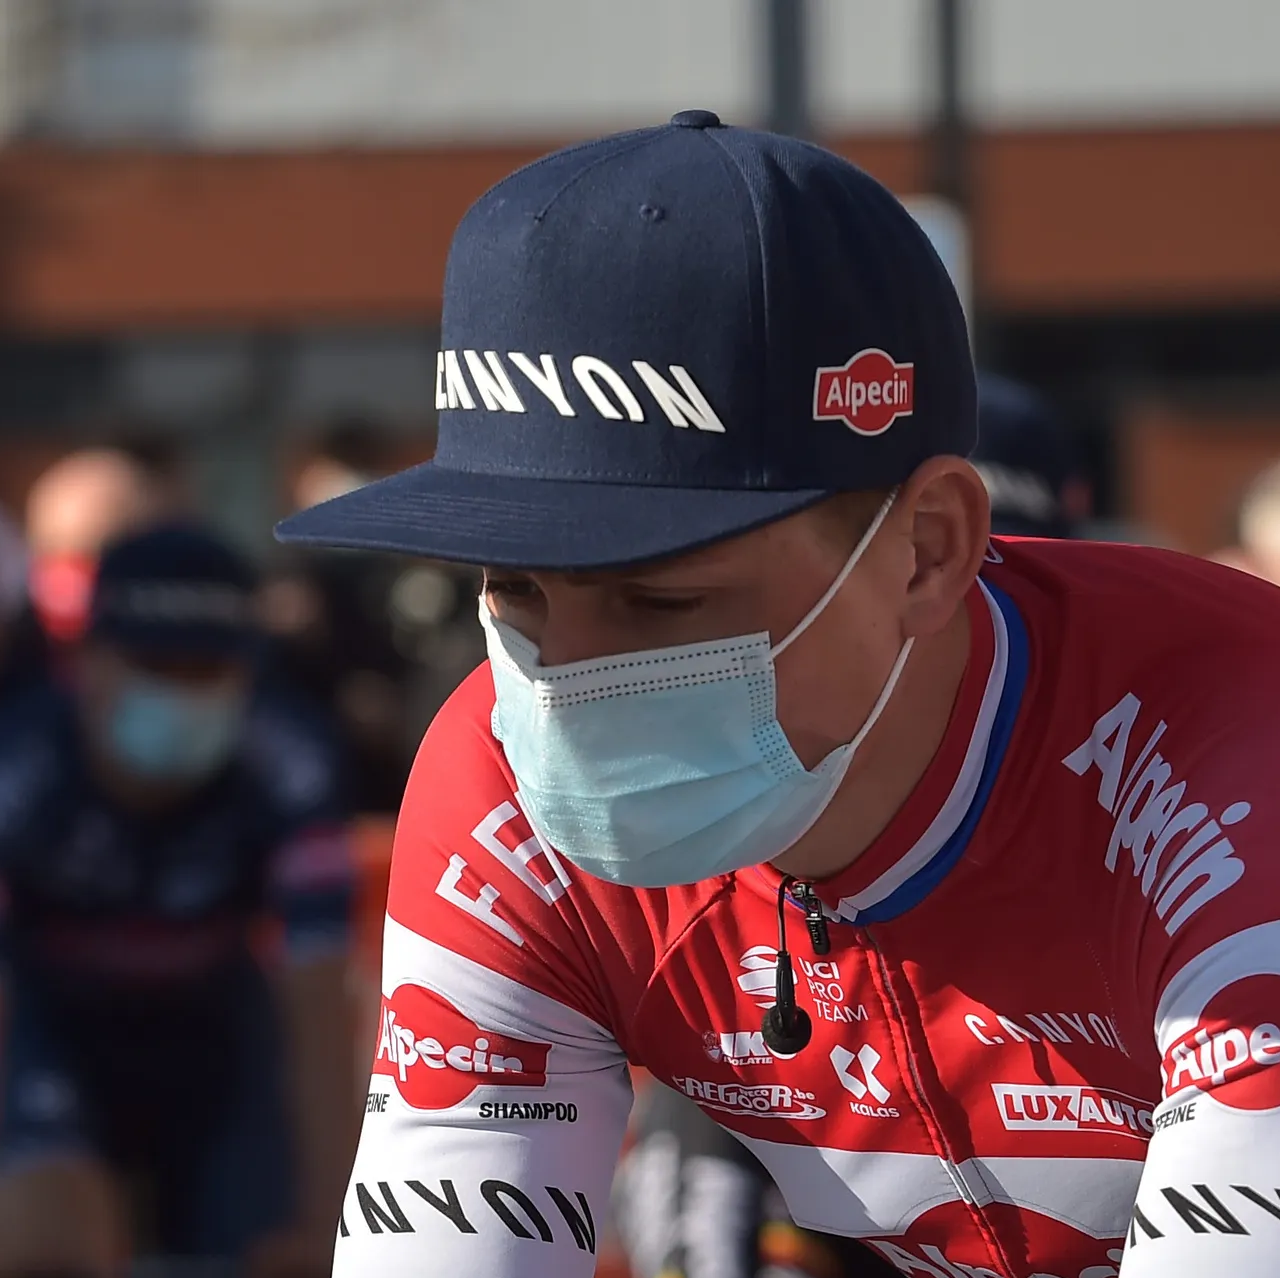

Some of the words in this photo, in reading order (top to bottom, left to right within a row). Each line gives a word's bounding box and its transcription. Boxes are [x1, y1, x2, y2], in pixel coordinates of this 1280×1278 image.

[825, 371, 908, 417] Alpecin
[1061, 691, 1251, 938] Alpecin
[798, 957, 840, 980] UCI
[807, 978, 844, 1003] PRO
[812, 998, 869, 1024] TEAM
[376, 1006, 525, 1083] Alpecin
[478, 1102, 578, 1123] SHAMPOO
[340, 1179, 596, 1256] NYON
